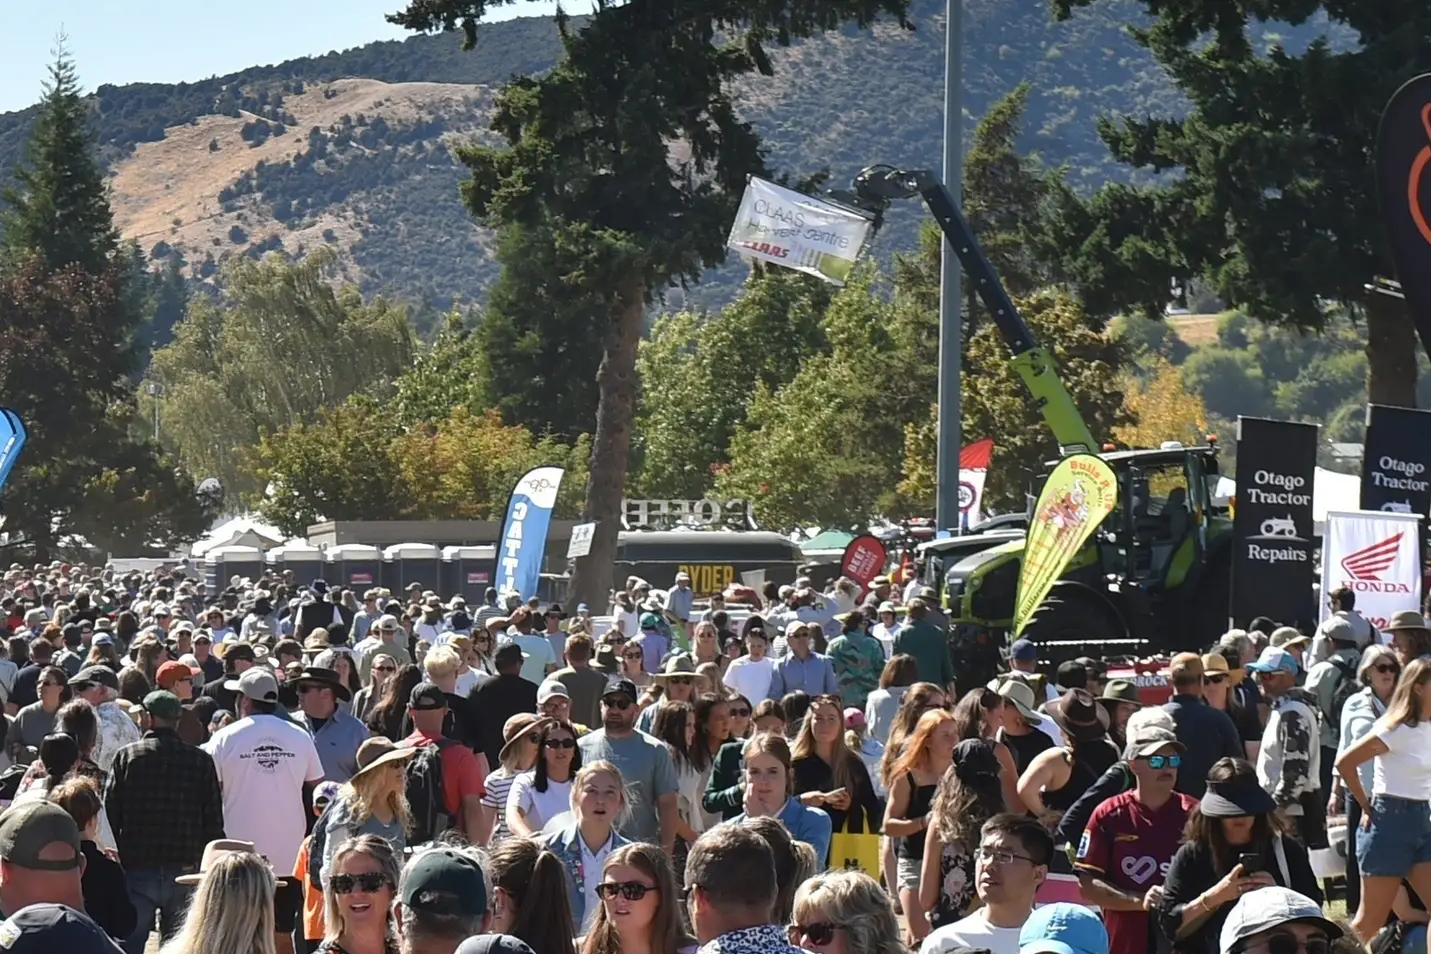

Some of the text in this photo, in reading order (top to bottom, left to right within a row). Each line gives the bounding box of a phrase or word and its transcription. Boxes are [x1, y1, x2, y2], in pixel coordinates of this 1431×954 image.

[754, 199, 806, 228] CLAAS
[803, 228, 850, 250] Centre
[1070, 460, 1100, 479] Bulls
[1379, 456, 1425, 477] Otago
[1254, 470, 1305, 490] Otago
[1371, 472, 1429, 492] Tractor
[1247, 488, 1311, 506] Tractor
[1248, 545, 1308, 563] Repairs
[1340, 581, 1411, 593] HONDA
